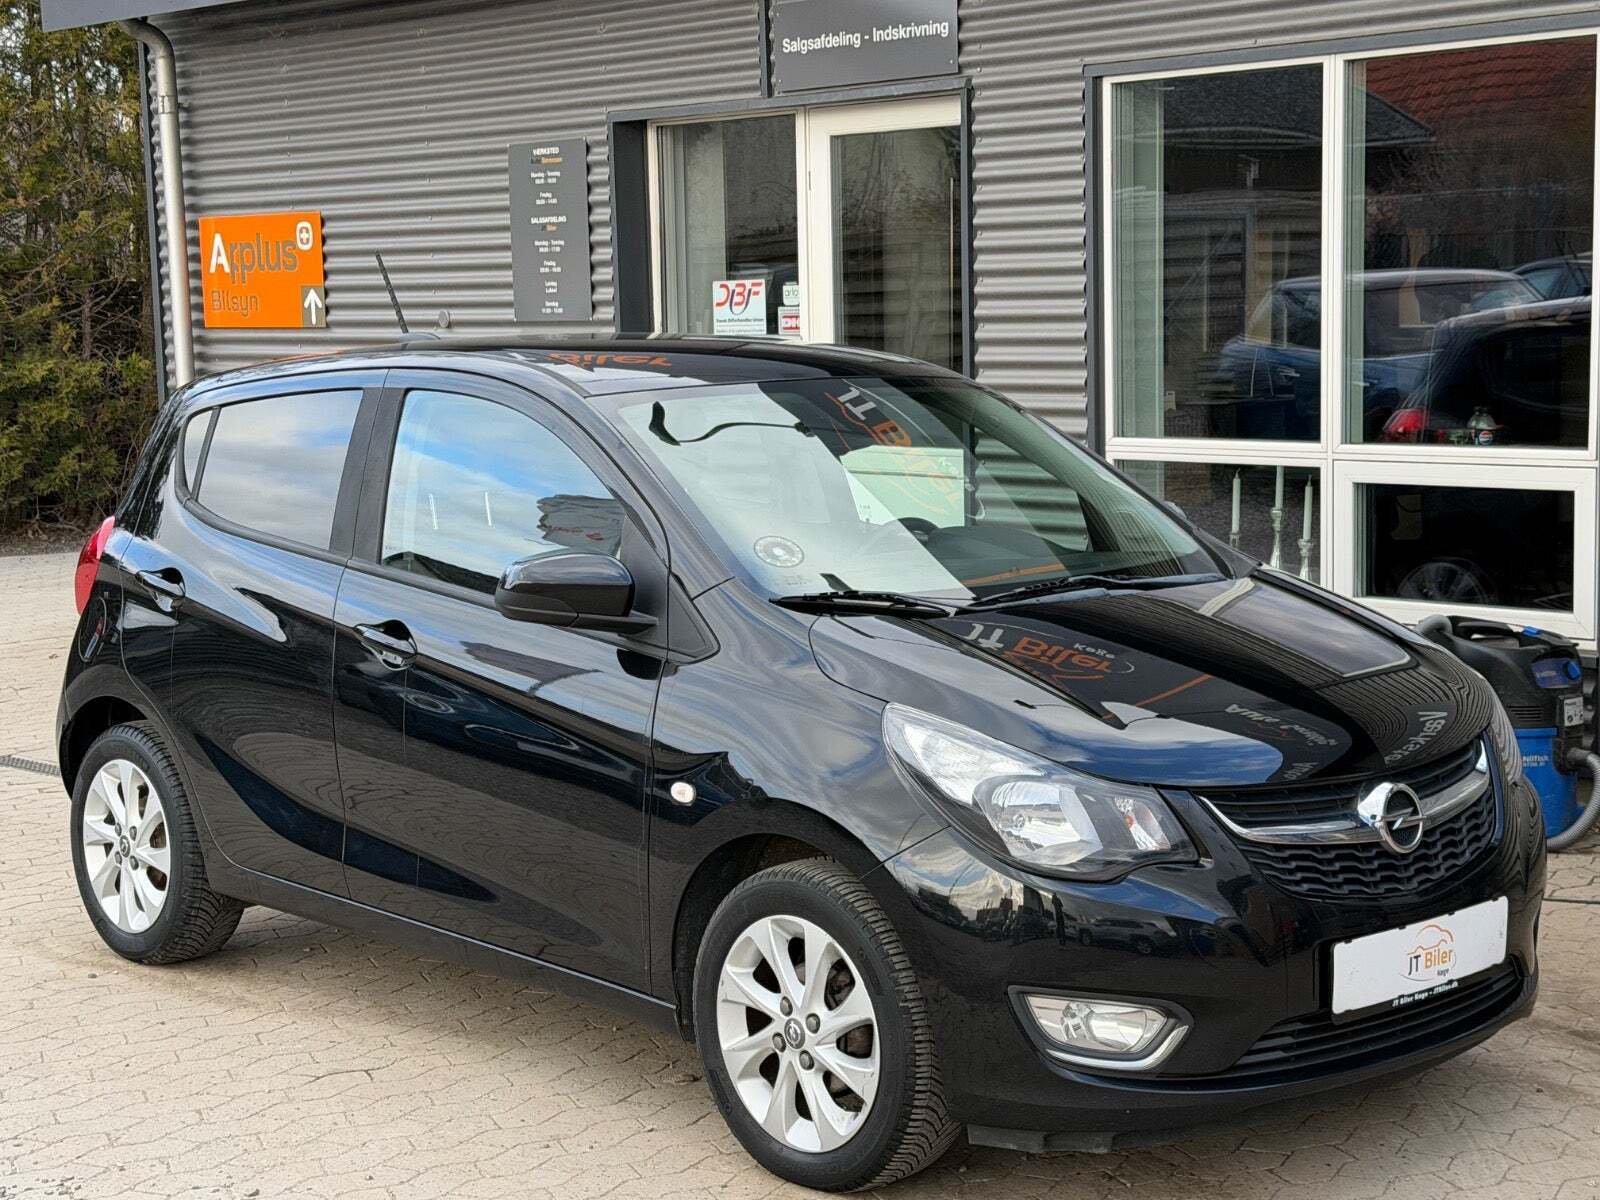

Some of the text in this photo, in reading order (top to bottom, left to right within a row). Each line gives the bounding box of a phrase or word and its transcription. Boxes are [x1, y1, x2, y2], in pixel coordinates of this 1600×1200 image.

[782, 31, 861, 54] Salgsafdeling
[873, 20, 949, 42] Indskrivning
[211, 290, 258, 317] Bilsyn
[1408, 948, 1454, 976] JT Biler
